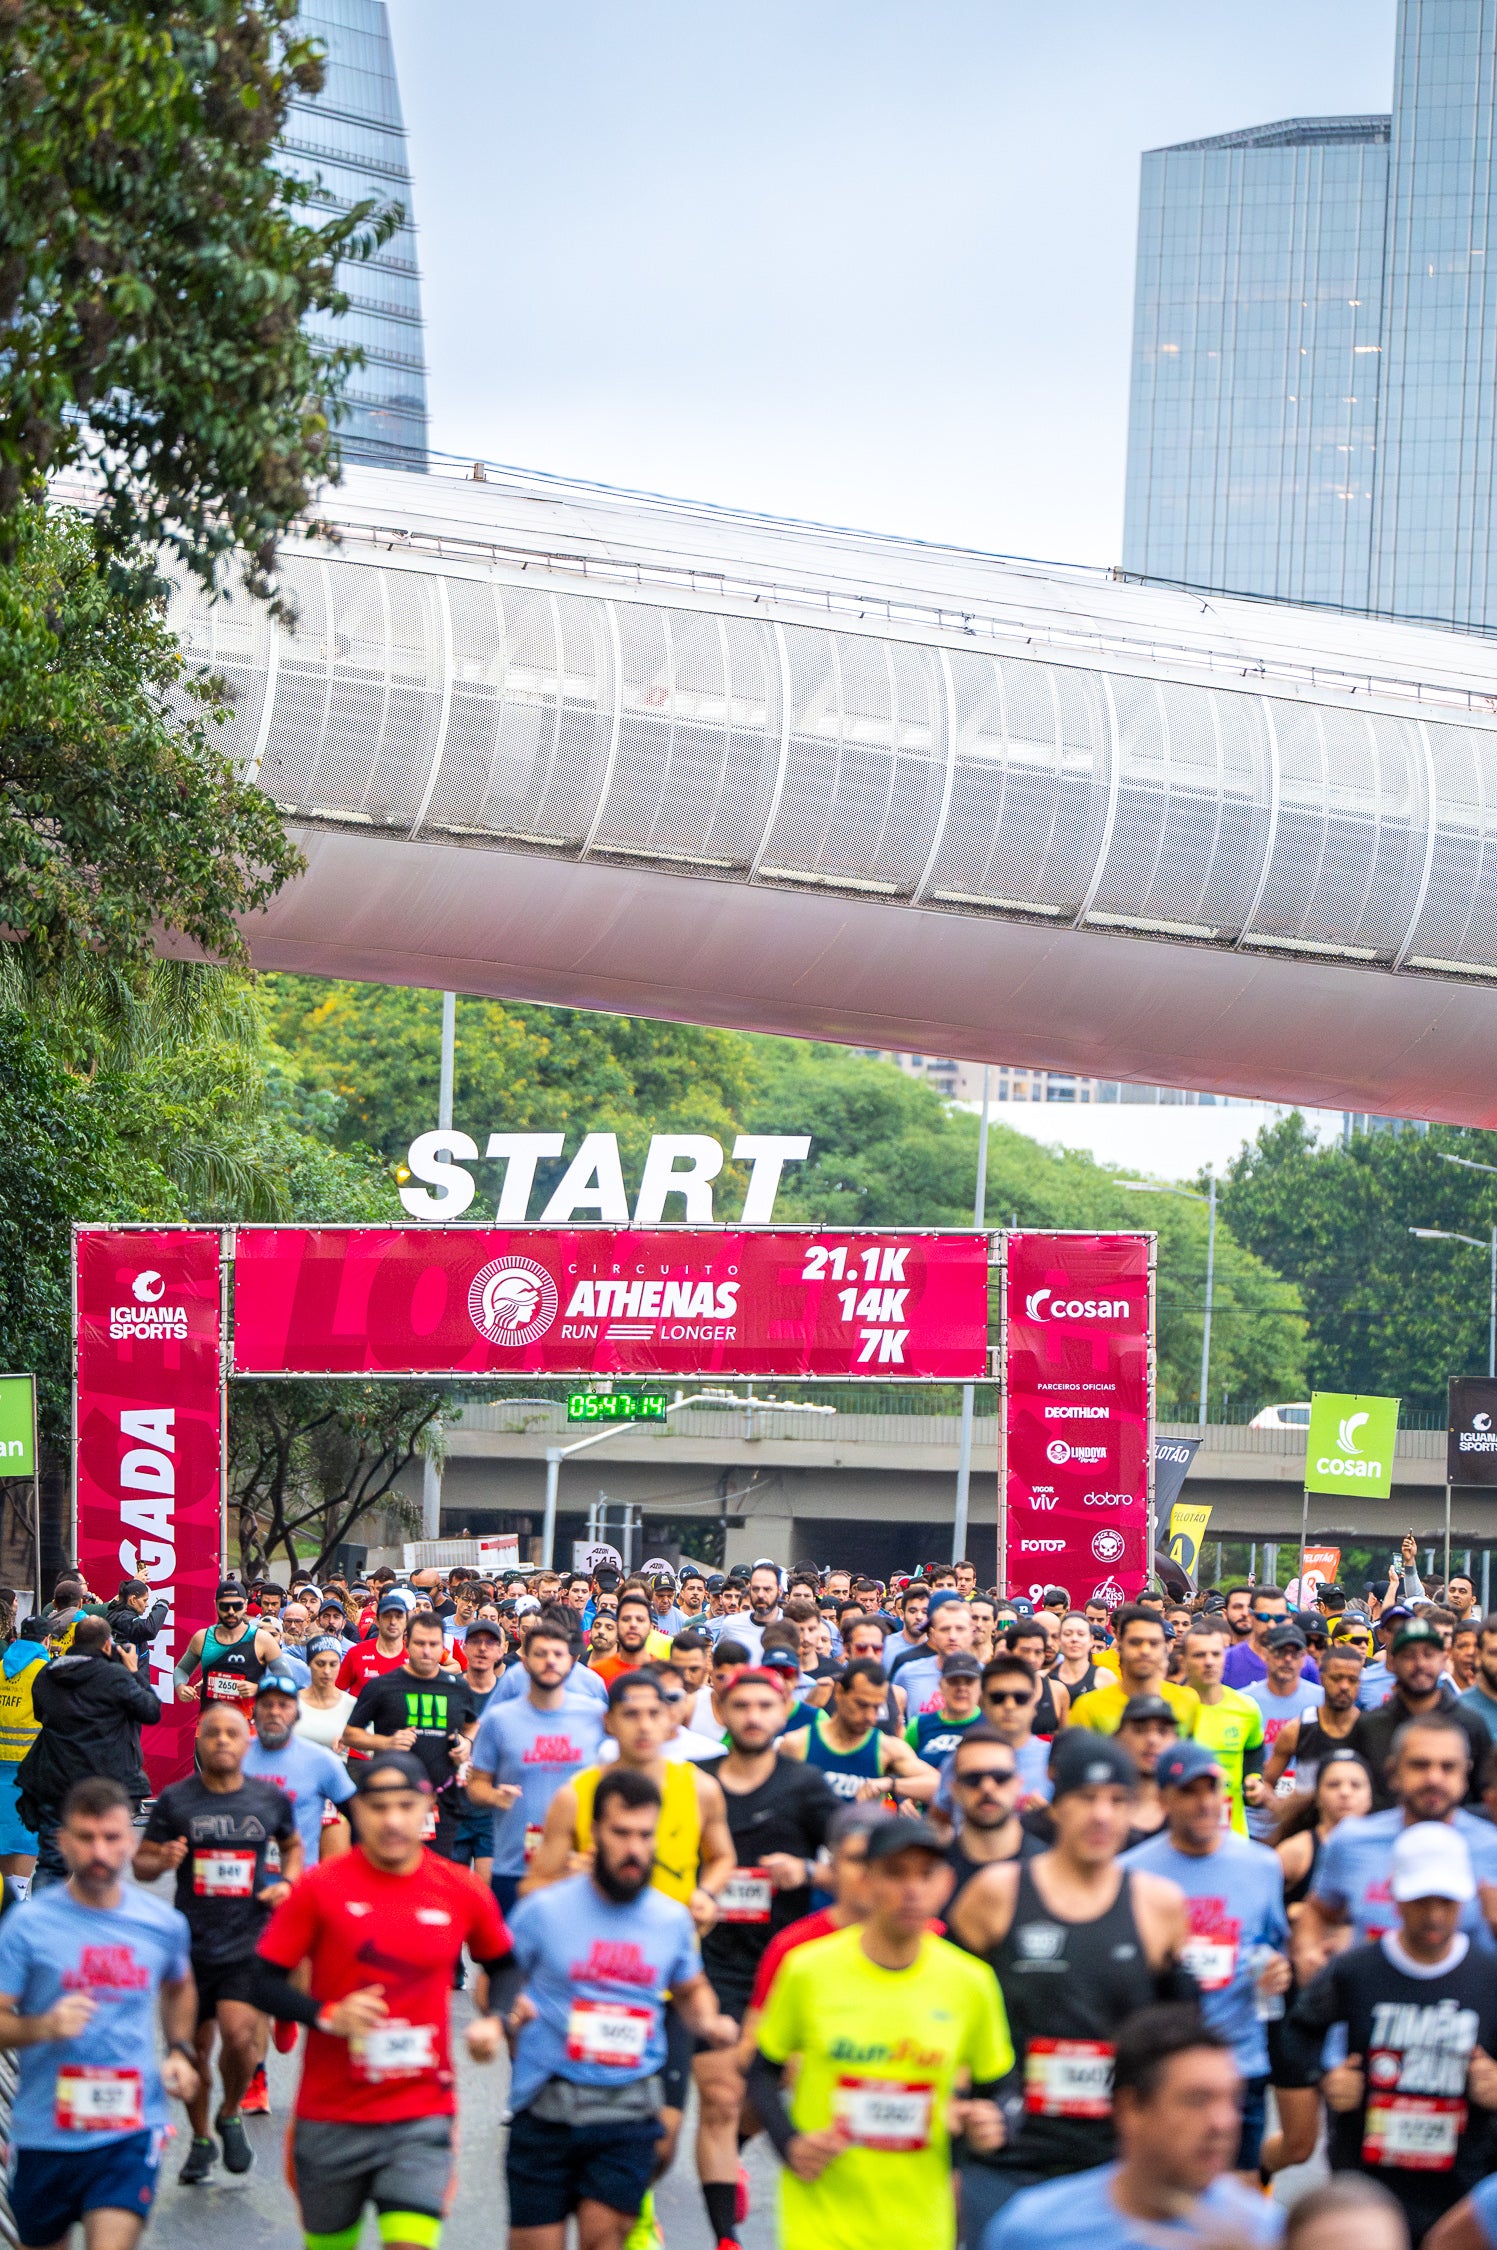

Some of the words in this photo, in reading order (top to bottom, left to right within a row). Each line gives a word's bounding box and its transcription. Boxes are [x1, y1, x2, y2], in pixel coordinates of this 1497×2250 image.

[399, 1129, 812, 1222] START
[568, 1263, 739, 1275] CIRCUITO
[802, 1245, 912, 1282] 21.1K
[565, 1280, 742, 1319] ATHENAS
[837, 1287, 911, 1322] 14K
[110, 1307, 188, 1323] IGUANA
[1050, 1300, 1130, 1319] cosan
[109, 1323, 188, 1340] SPORTS
[561, 1324, 598, 1339] RUN
[661, 1325, 737, 1340] LONGER
[856, 1328, 911, 1363] 7K
[1037, 1383, 1081, 1391] PARCEIROS
[1082, 1383, 1117, 1391] OFICIAIS
[569, 1395, 664, 1416] 05:47:14
[1044, 1407, 1110, 1419] DECATHLON
[1460, 1432, 1497, 1443] IGUAN
[1316, 1457, 1382, 1479] cosan
[1032, 1485, 1054, 1493] VIGOR
[1083, 1491, 1133, 1505] dobro
[1021, 1540, 1067, 1552] FOTOP
[189, 1814, 266, 1842] FILA
